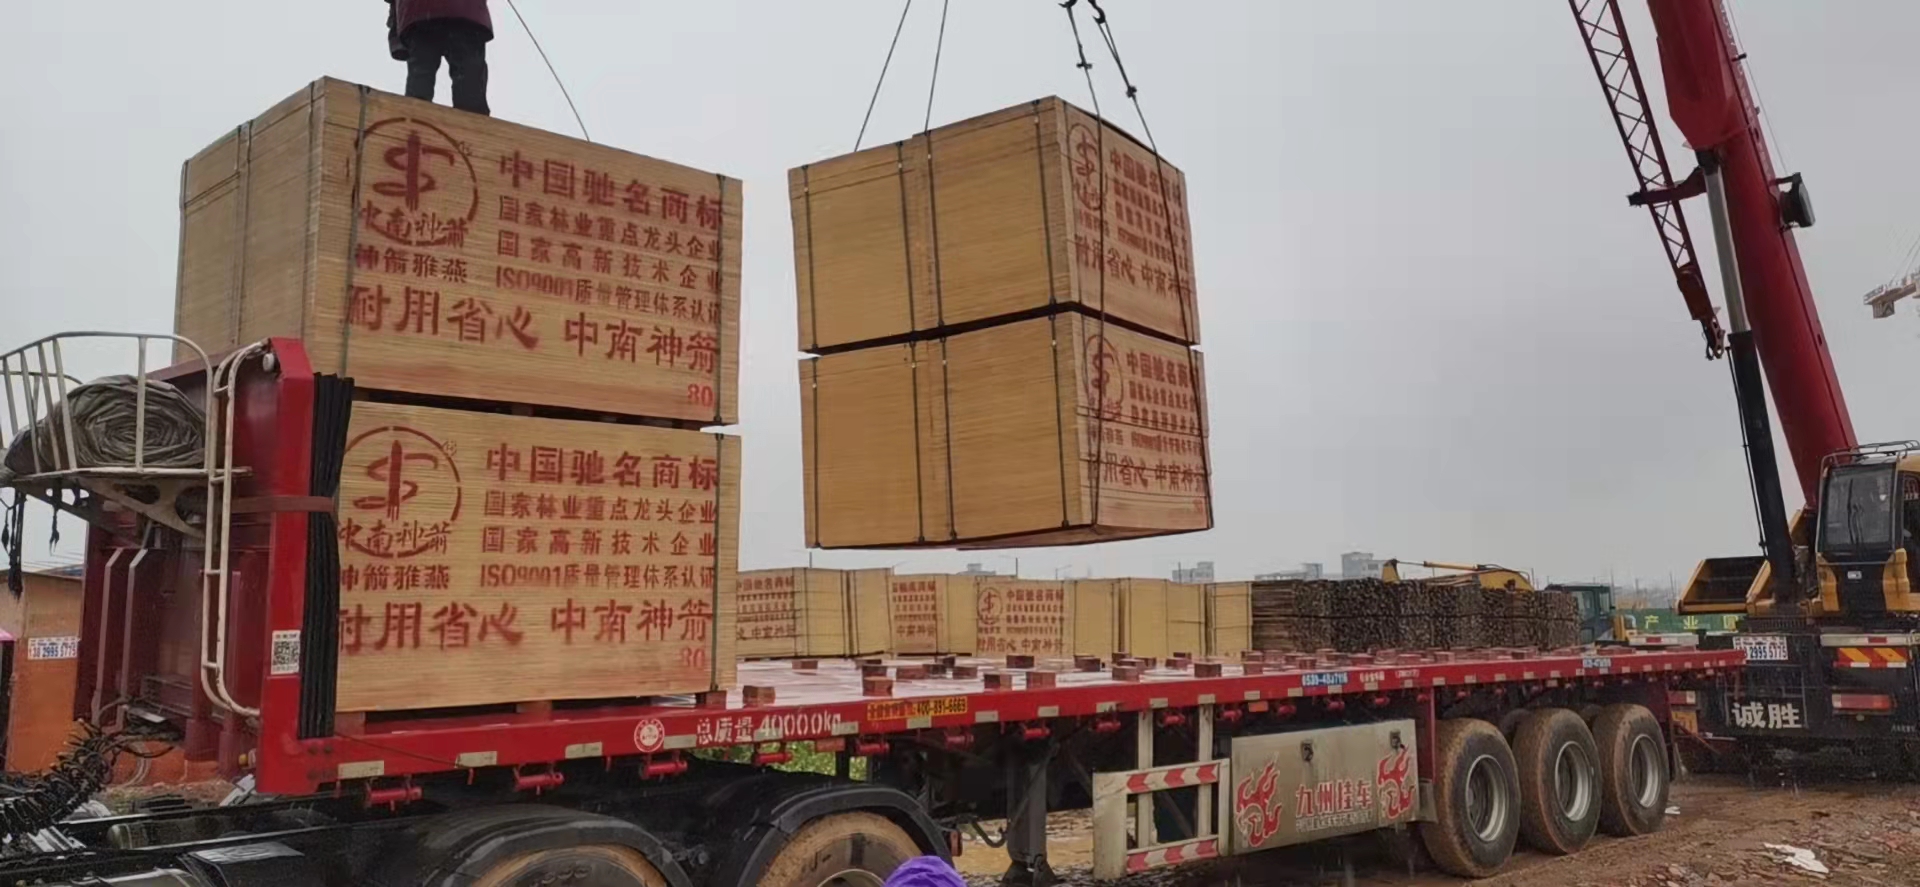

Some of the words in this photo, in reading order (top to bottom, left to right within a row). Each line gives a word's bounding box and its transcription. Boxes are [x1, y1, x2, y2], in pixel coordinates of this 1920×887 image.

[500, 149, 723, 231] 中国驰名商标
[500, 195, 721, 262] 国家林业重点龙头企业
[497, 230, 721, 293] 国家高新技术企业
[349, 284, 539, 350] 耐用省心
[564, 311, 720, 374] 中南神箭
[486, 443, 718, 490] 中国驰名商标
[484, 489, 716, 525] 国家林业重点龙头企业
[481, 526, 716, 557] 国家高新技术企业
[551, 597, 713, 645] 中南神箭
[696, 716, 753, 745] 总质量
[1731, 702, 1802, 729] 诚胜
[1296, 779, 1373, 817] 九州挂车
